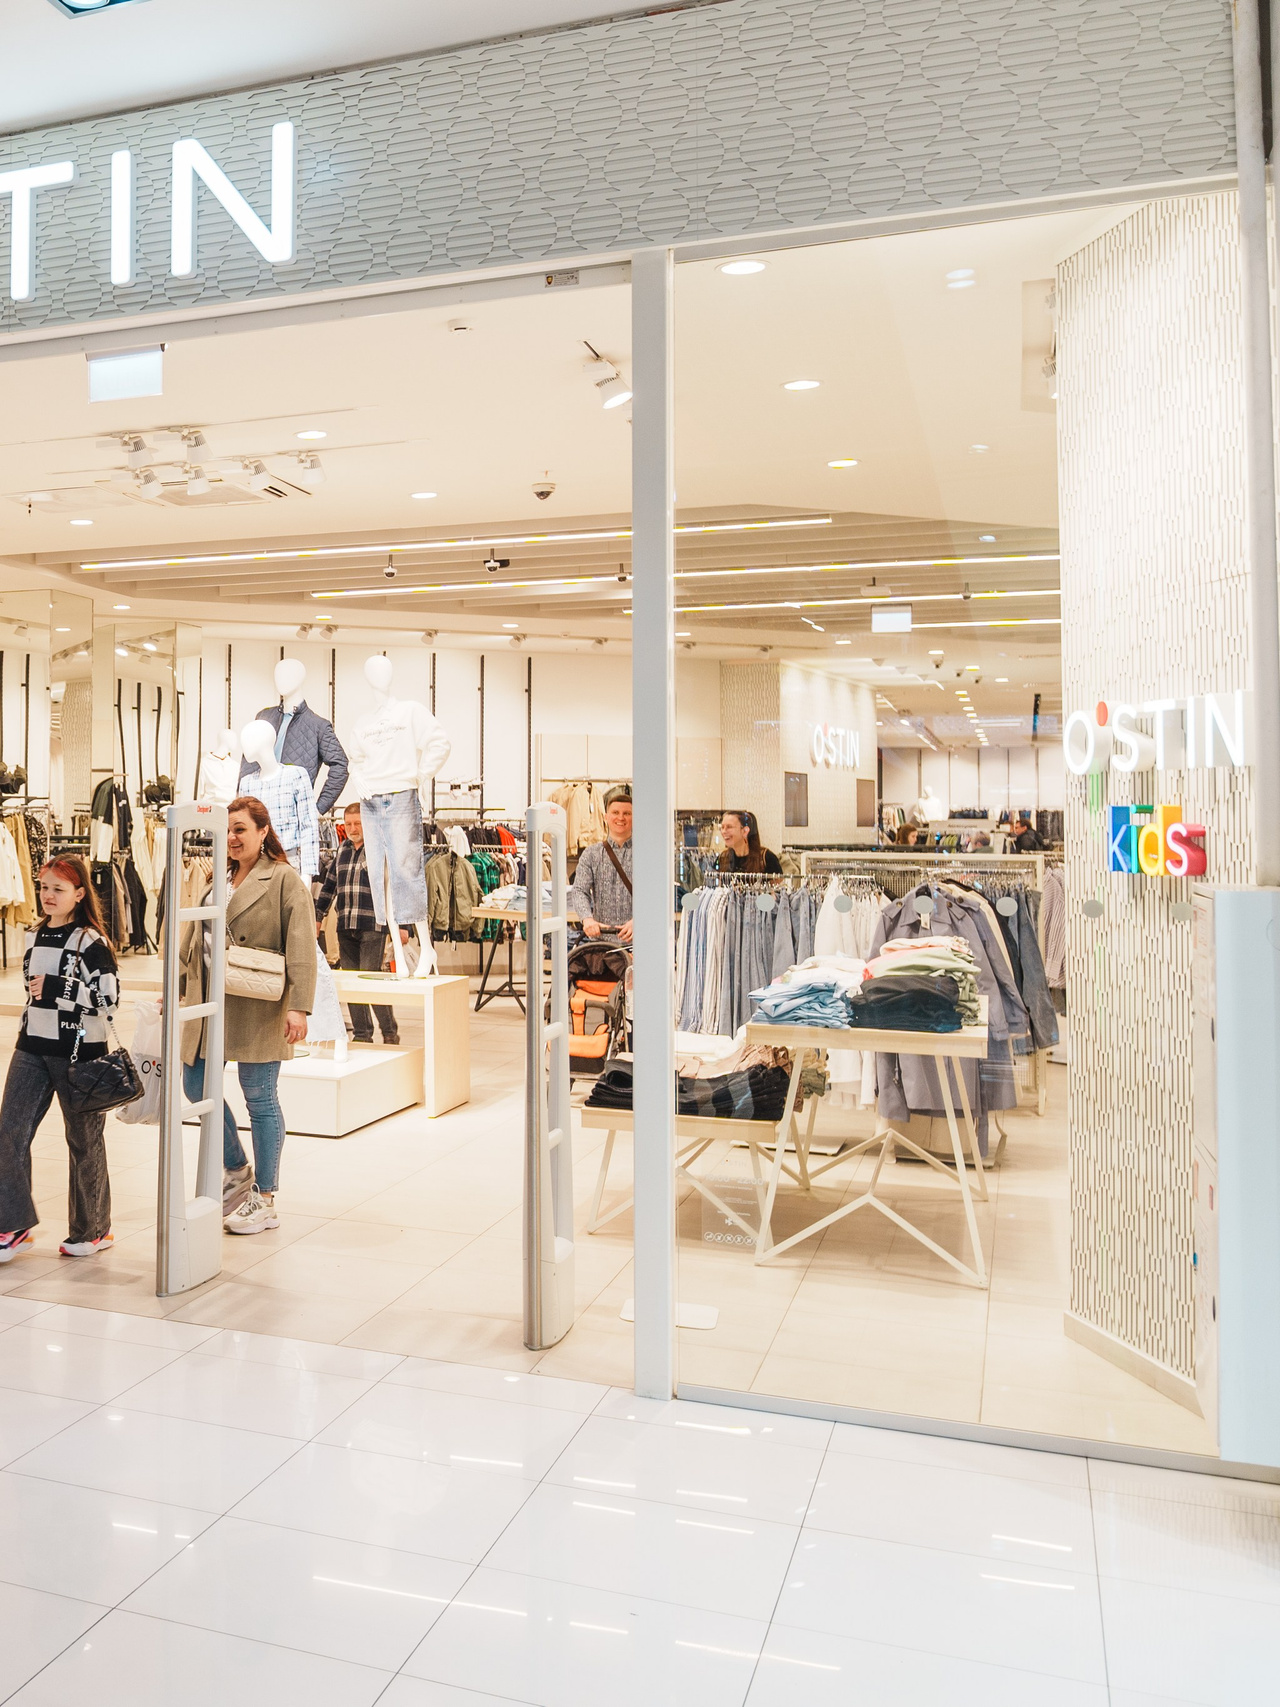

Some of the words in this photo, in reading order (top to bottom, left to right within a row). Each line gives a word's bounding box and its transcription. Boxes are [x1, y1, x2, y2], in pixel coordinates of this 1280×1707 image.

[813, 722, 860, 768] O'STIN
[1063, 689, 1245, 776] O'STIN
[1107, 805, 1190, 877] kids
